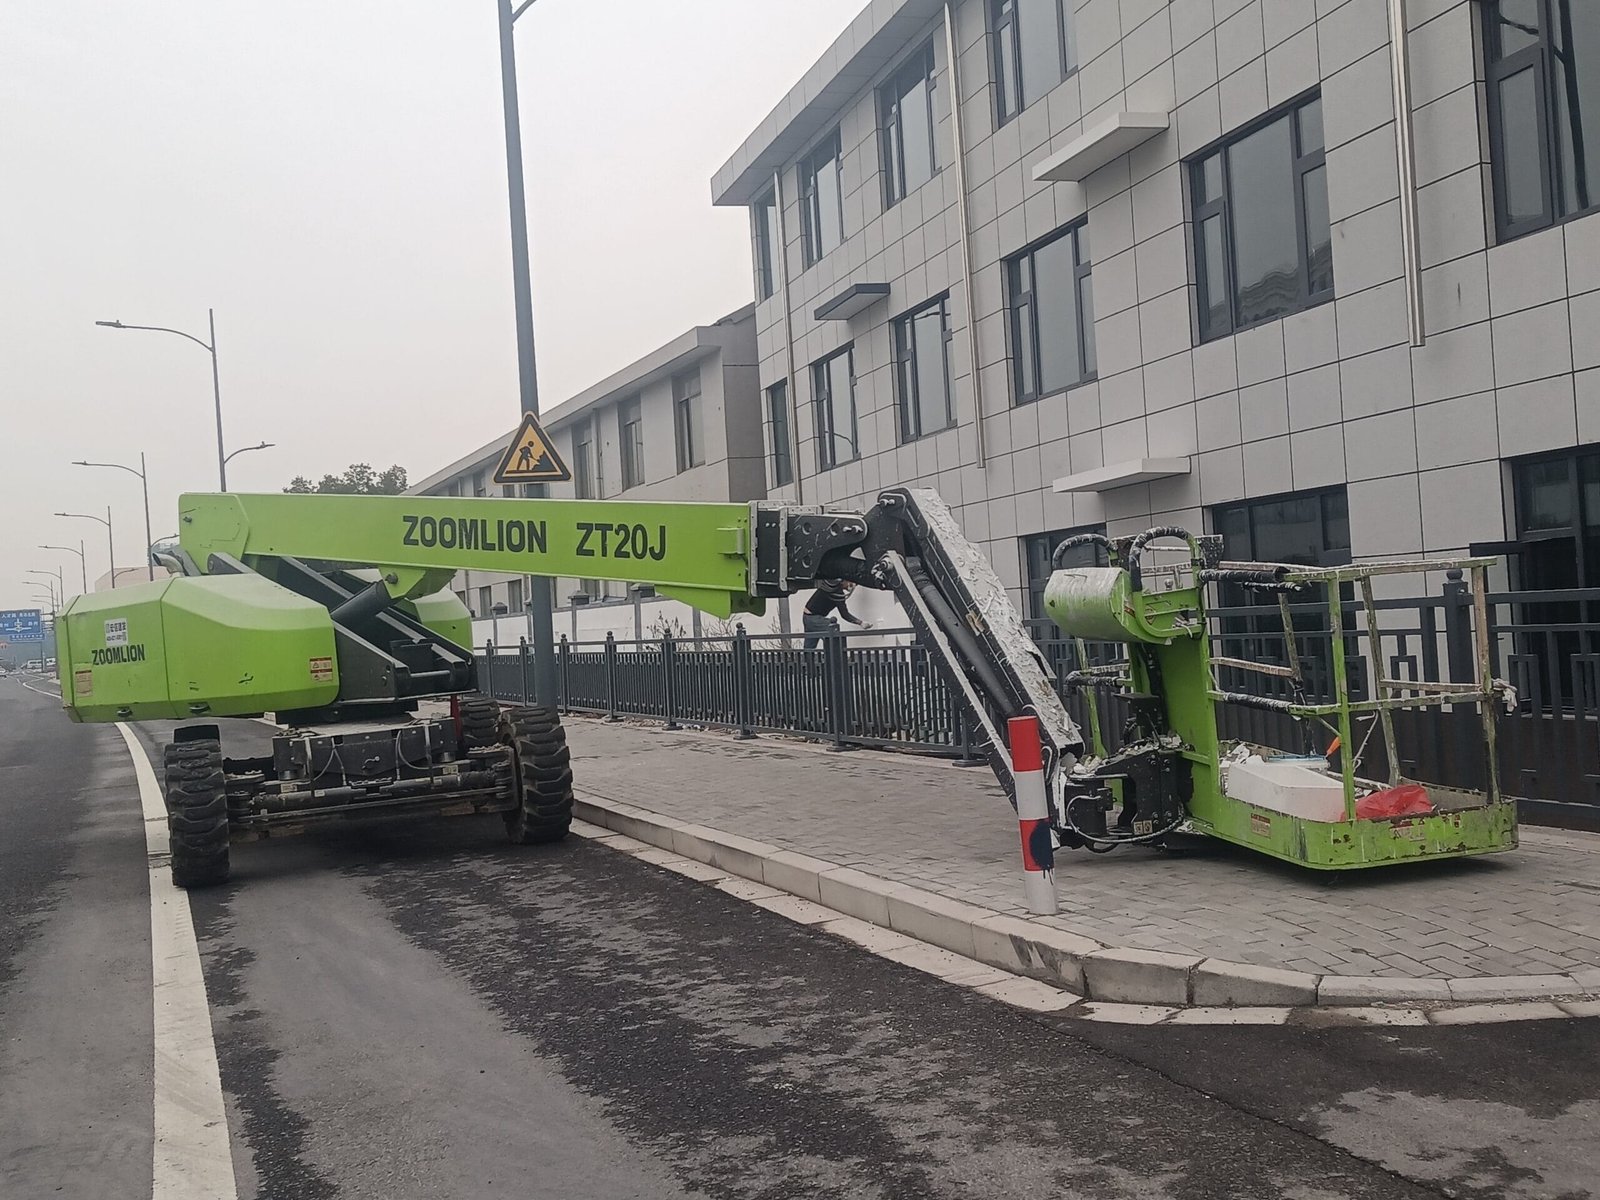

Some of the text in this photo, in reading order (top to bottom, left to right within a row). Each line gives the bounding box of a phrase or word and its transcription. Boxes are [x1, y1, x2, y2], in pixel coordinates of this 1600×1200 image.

[402, 515, 667, 561] ZOOMLION ZT20J
[91, 644, 145, 665] ZOOMLION
